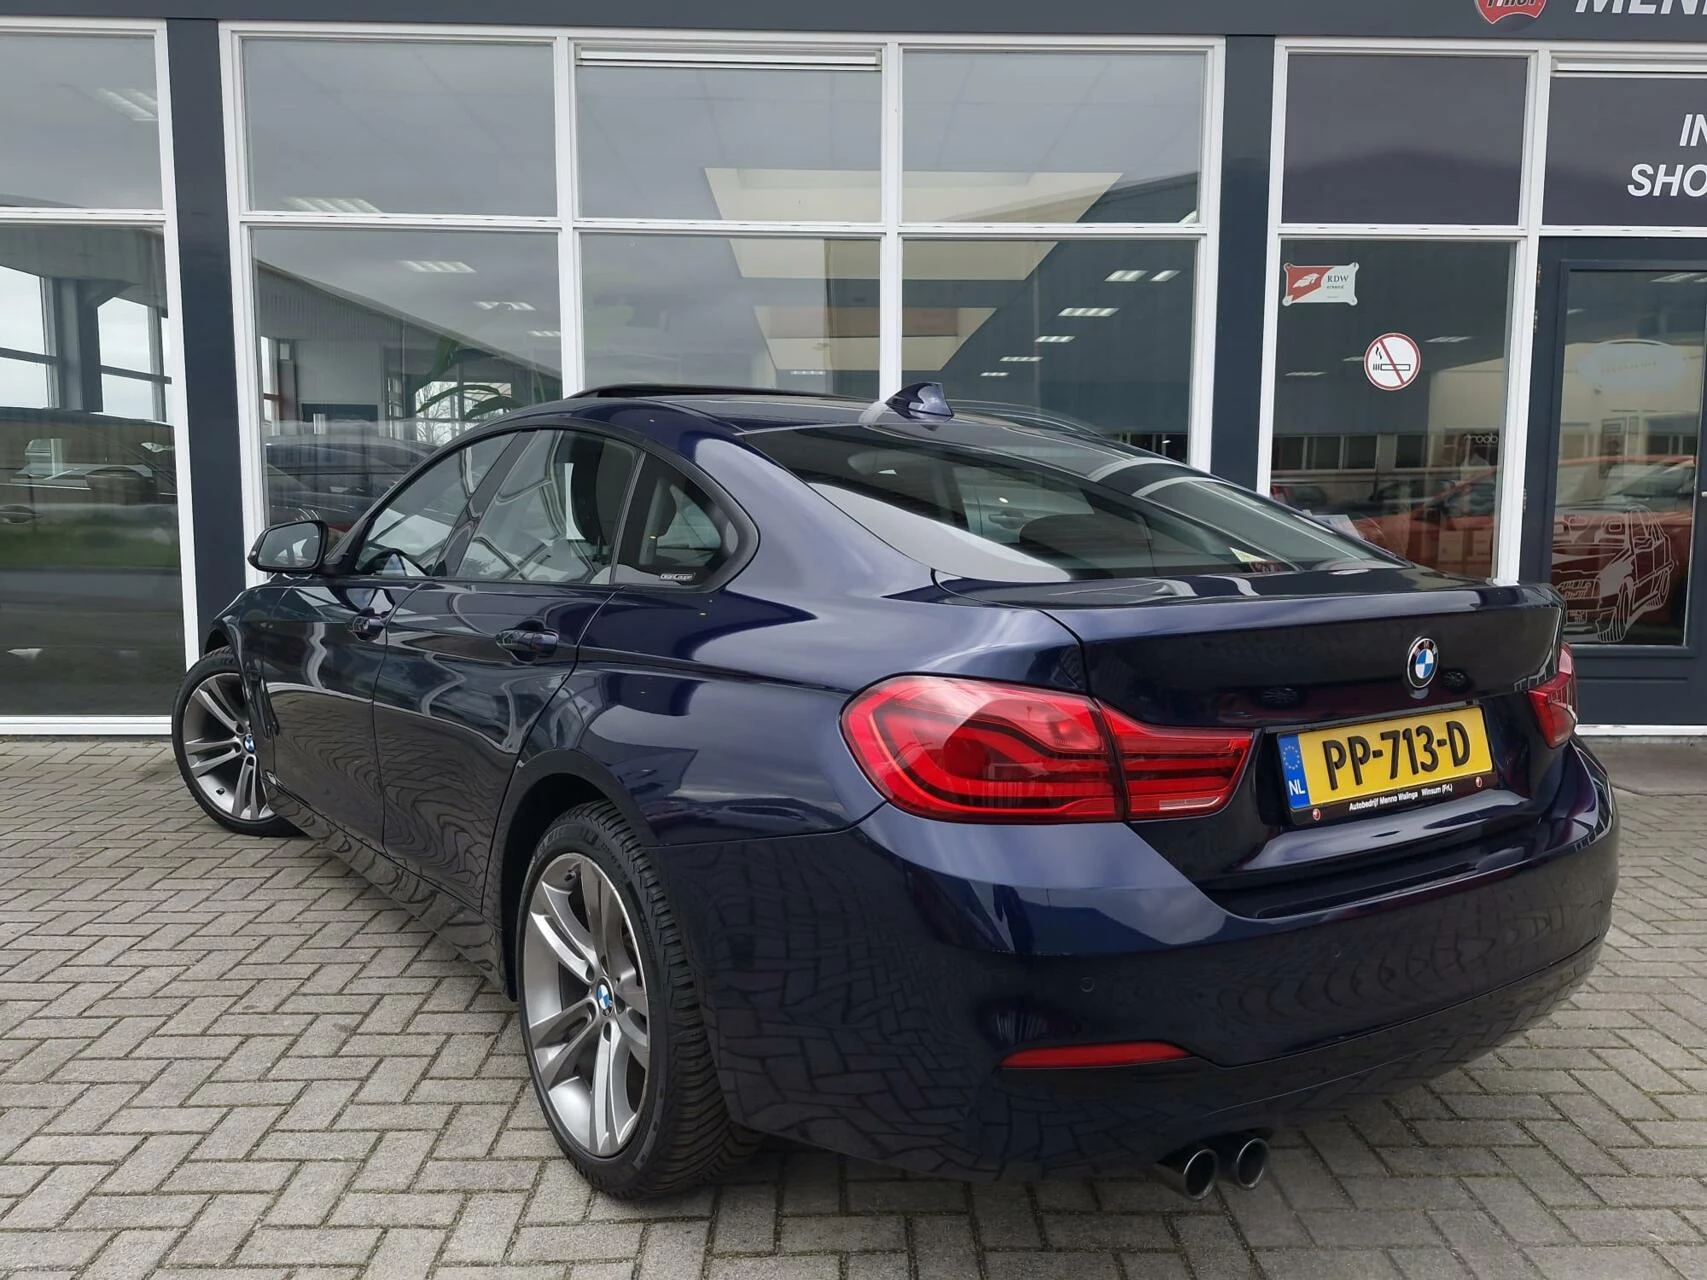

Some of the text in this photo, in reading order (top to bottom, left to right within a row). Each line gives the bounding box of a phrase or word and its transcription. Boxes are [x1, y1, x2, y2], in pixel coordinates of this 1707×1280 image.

[1627, 163, 1707, 197] SHO
[1327, 274, 1349, 283] RDW
[1322, 720, 1471, 791] PP-713-D
[1288, 779, 1306, 796] NL
[1349, 799, 1379, 811] Autobedrijf
[1380, 795, 1397, 805] Menno
